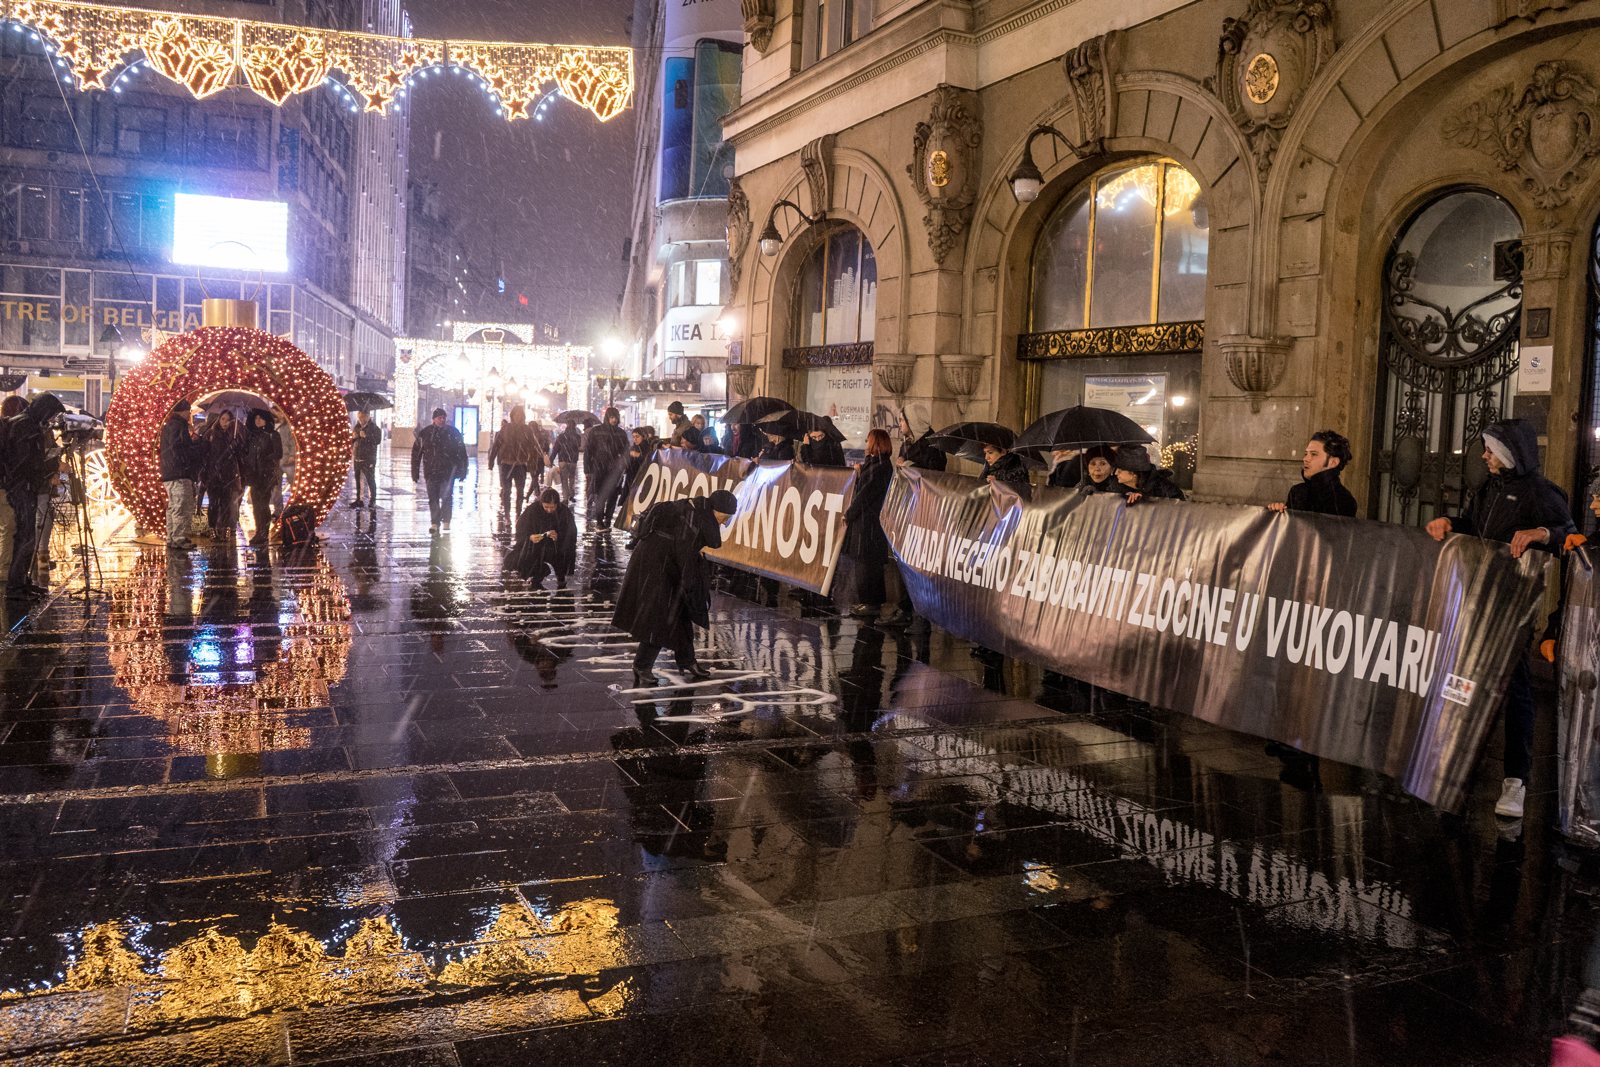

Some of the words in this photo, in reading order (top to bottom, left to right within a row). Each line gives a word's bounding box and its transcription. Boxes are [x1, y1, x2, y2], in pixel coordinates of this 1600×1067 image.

[0, 301, 52, 321] TRE
[62, 304, 93, 324] OF
[671, 323, 702, 341] IKEA
[828, 379, 842, 389] THE
[843, 379, 862, 389] RIGHT
[633, 463, 844, 567] ODGORNOST
[901, 523, 946, 575] NIKADA
[944, 531, 1011, 592] NEĆEMO
[1010, 550, 1131, 621] ZABORAVITI
[1128, 567, 1236, 646] ZLOČINE
[1236, 592, 1259, 652] U
[1266, 597, 1441, 698] VUKOVARU
